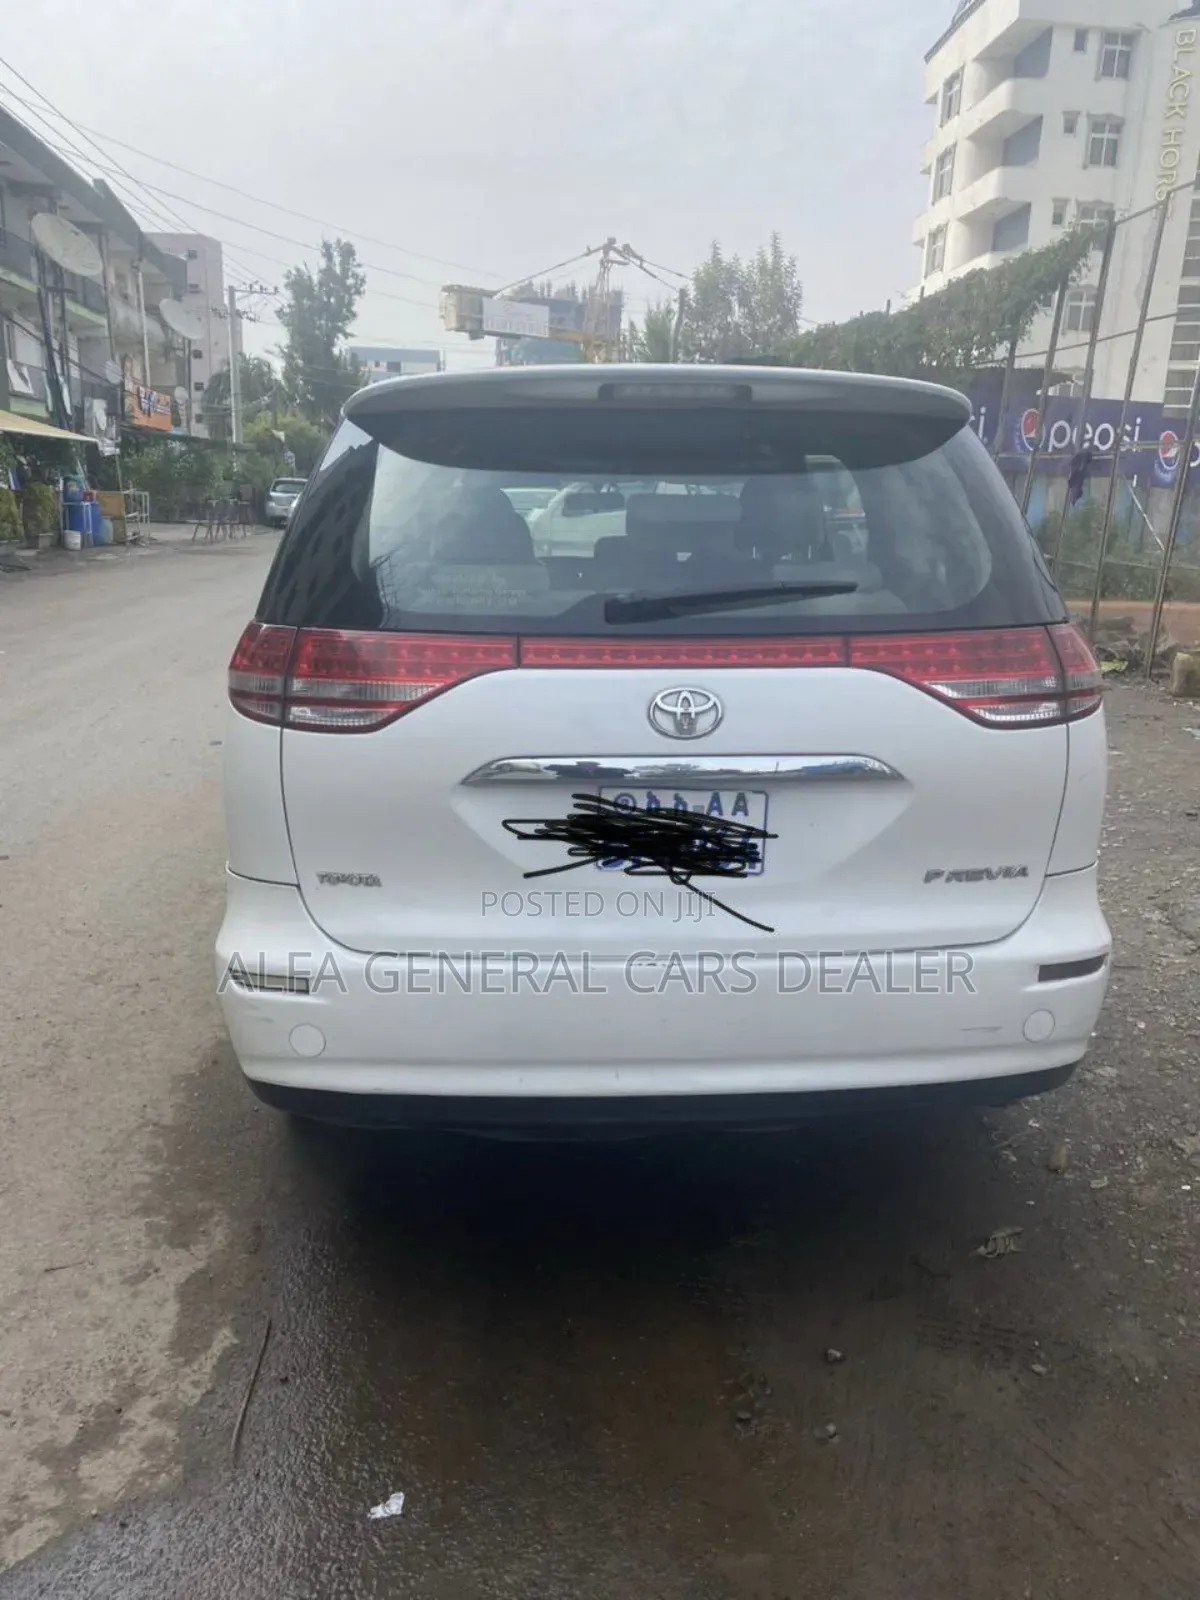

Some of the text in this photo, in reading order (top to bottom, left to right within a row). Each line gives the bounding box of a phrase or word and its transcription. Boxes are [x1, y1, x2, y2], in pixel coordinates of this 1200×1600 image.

[1164, 28, 1197, 120] BLACK
[316, 870, 382, 887] TOYOTA
[923, 866, 1029, 884] PREVIA
